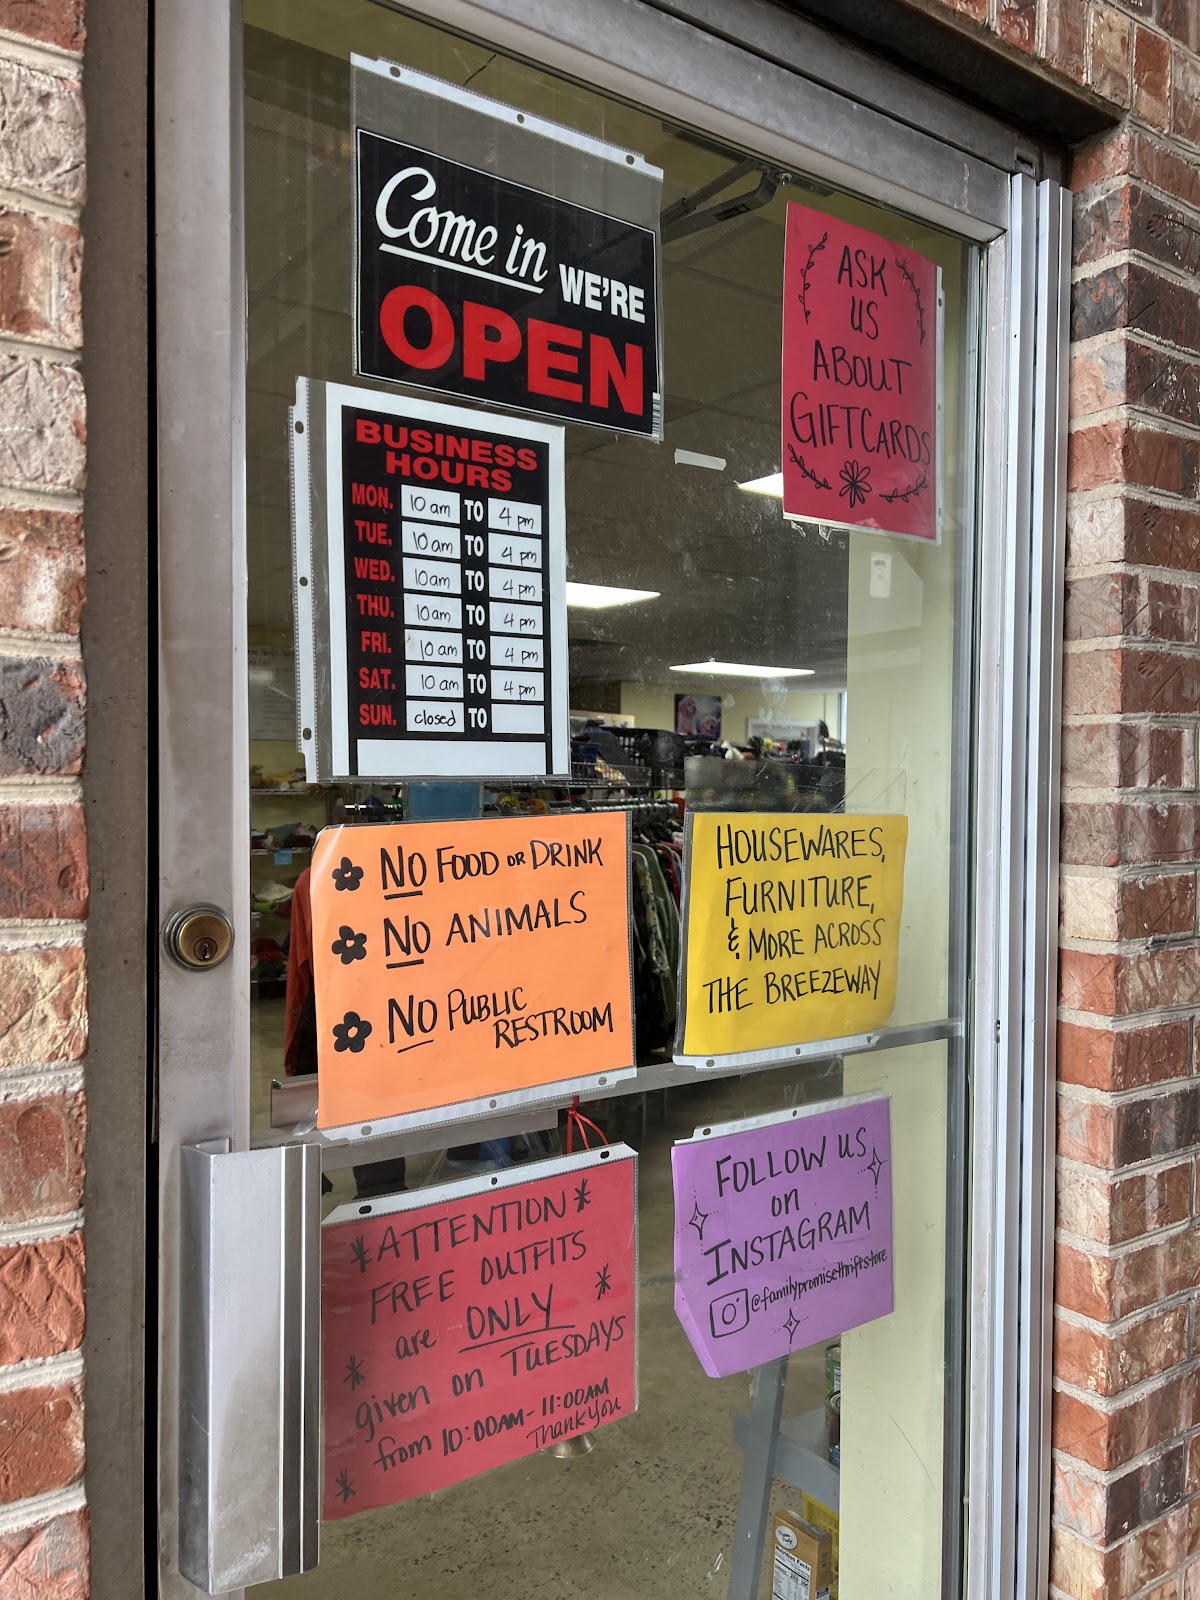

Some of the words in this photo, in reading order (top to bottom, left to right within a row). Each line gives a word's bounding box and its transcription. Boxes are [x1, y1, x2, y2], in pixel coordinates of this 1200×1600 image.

[376, 166, 498, 266] Come
[505, 224, 548, 282] in
[558, 264, 646, 324] WE'RE
[838, 245, 888, 297] ASK
[851, 296, 880, 341] US
[380, 285, 644, 416] OPEN
[813, 339, 912, 394] ABOUT
[356, 419, 538, 471] BUSINESS
[385, 452, 512, 492] HOURS
[352, 483, 394, 510] MON.
[464, 500, 484, 522] TO
[354, 520, 392, 545] TUE.
[464, 534, 484, 557] TO
[354, 557, 395, 582] WED.
[465, 569, 484, 592] TO
[356, 594, 394, 618] THU.
[466, 604, 485, 626] TO
[361, 631, 392, 654] FRI.
[466, 639, 486, 661] TO
[360, 667, 396, 690] SAT.
[468, 673, 487, 694] TO
[360, 704, 397, 726] SUN.
[414, 708, 457, 727] closed
[468, 707, 487, 729] TO
[380, 846, 427, 890] NO
[436, 846, 499, 883] FOOD
[530, 837, 604, 870] DRINK
[716, 823, 886, 869] HOUSEWARES,
[726, 874, 874, 916] FURNITURE,
[383, 915, 431, 957] NO
[445, 890, 588, 946] ANIMALS
[728, 918, 740, 960] &
[749, 928, 804, 962] MORE
[814, 918, 886, 954] ACROSS
[702, 976, 754, 1014] THE
[764, 960, 881, 1004] BREEZEWAY
[388, 995, 438, 1044] NO
[447, 987, 528, 1031] PUBLIC
[493, 1003, 614, 1050] RESTROOM
[716, 1136, 826, 1198] FOLLOW
[770, 1188, 800, 1218] on
[704, 1200, 872, 1286] INSTAGRAM
[369, 1270, 456, 1325] FREE
[480, 1230, 587, 1286] OUTFITS
[395, 1328, 436, 1360] are
[466, 1284, 554, 1340] ONLY
[354, 1384, 430, 1443] given
[452, 1368, 484, 1397] on
[500, 1315, 626, 1376] TUESDAYS
[373, 1435, 432, 1472] from
